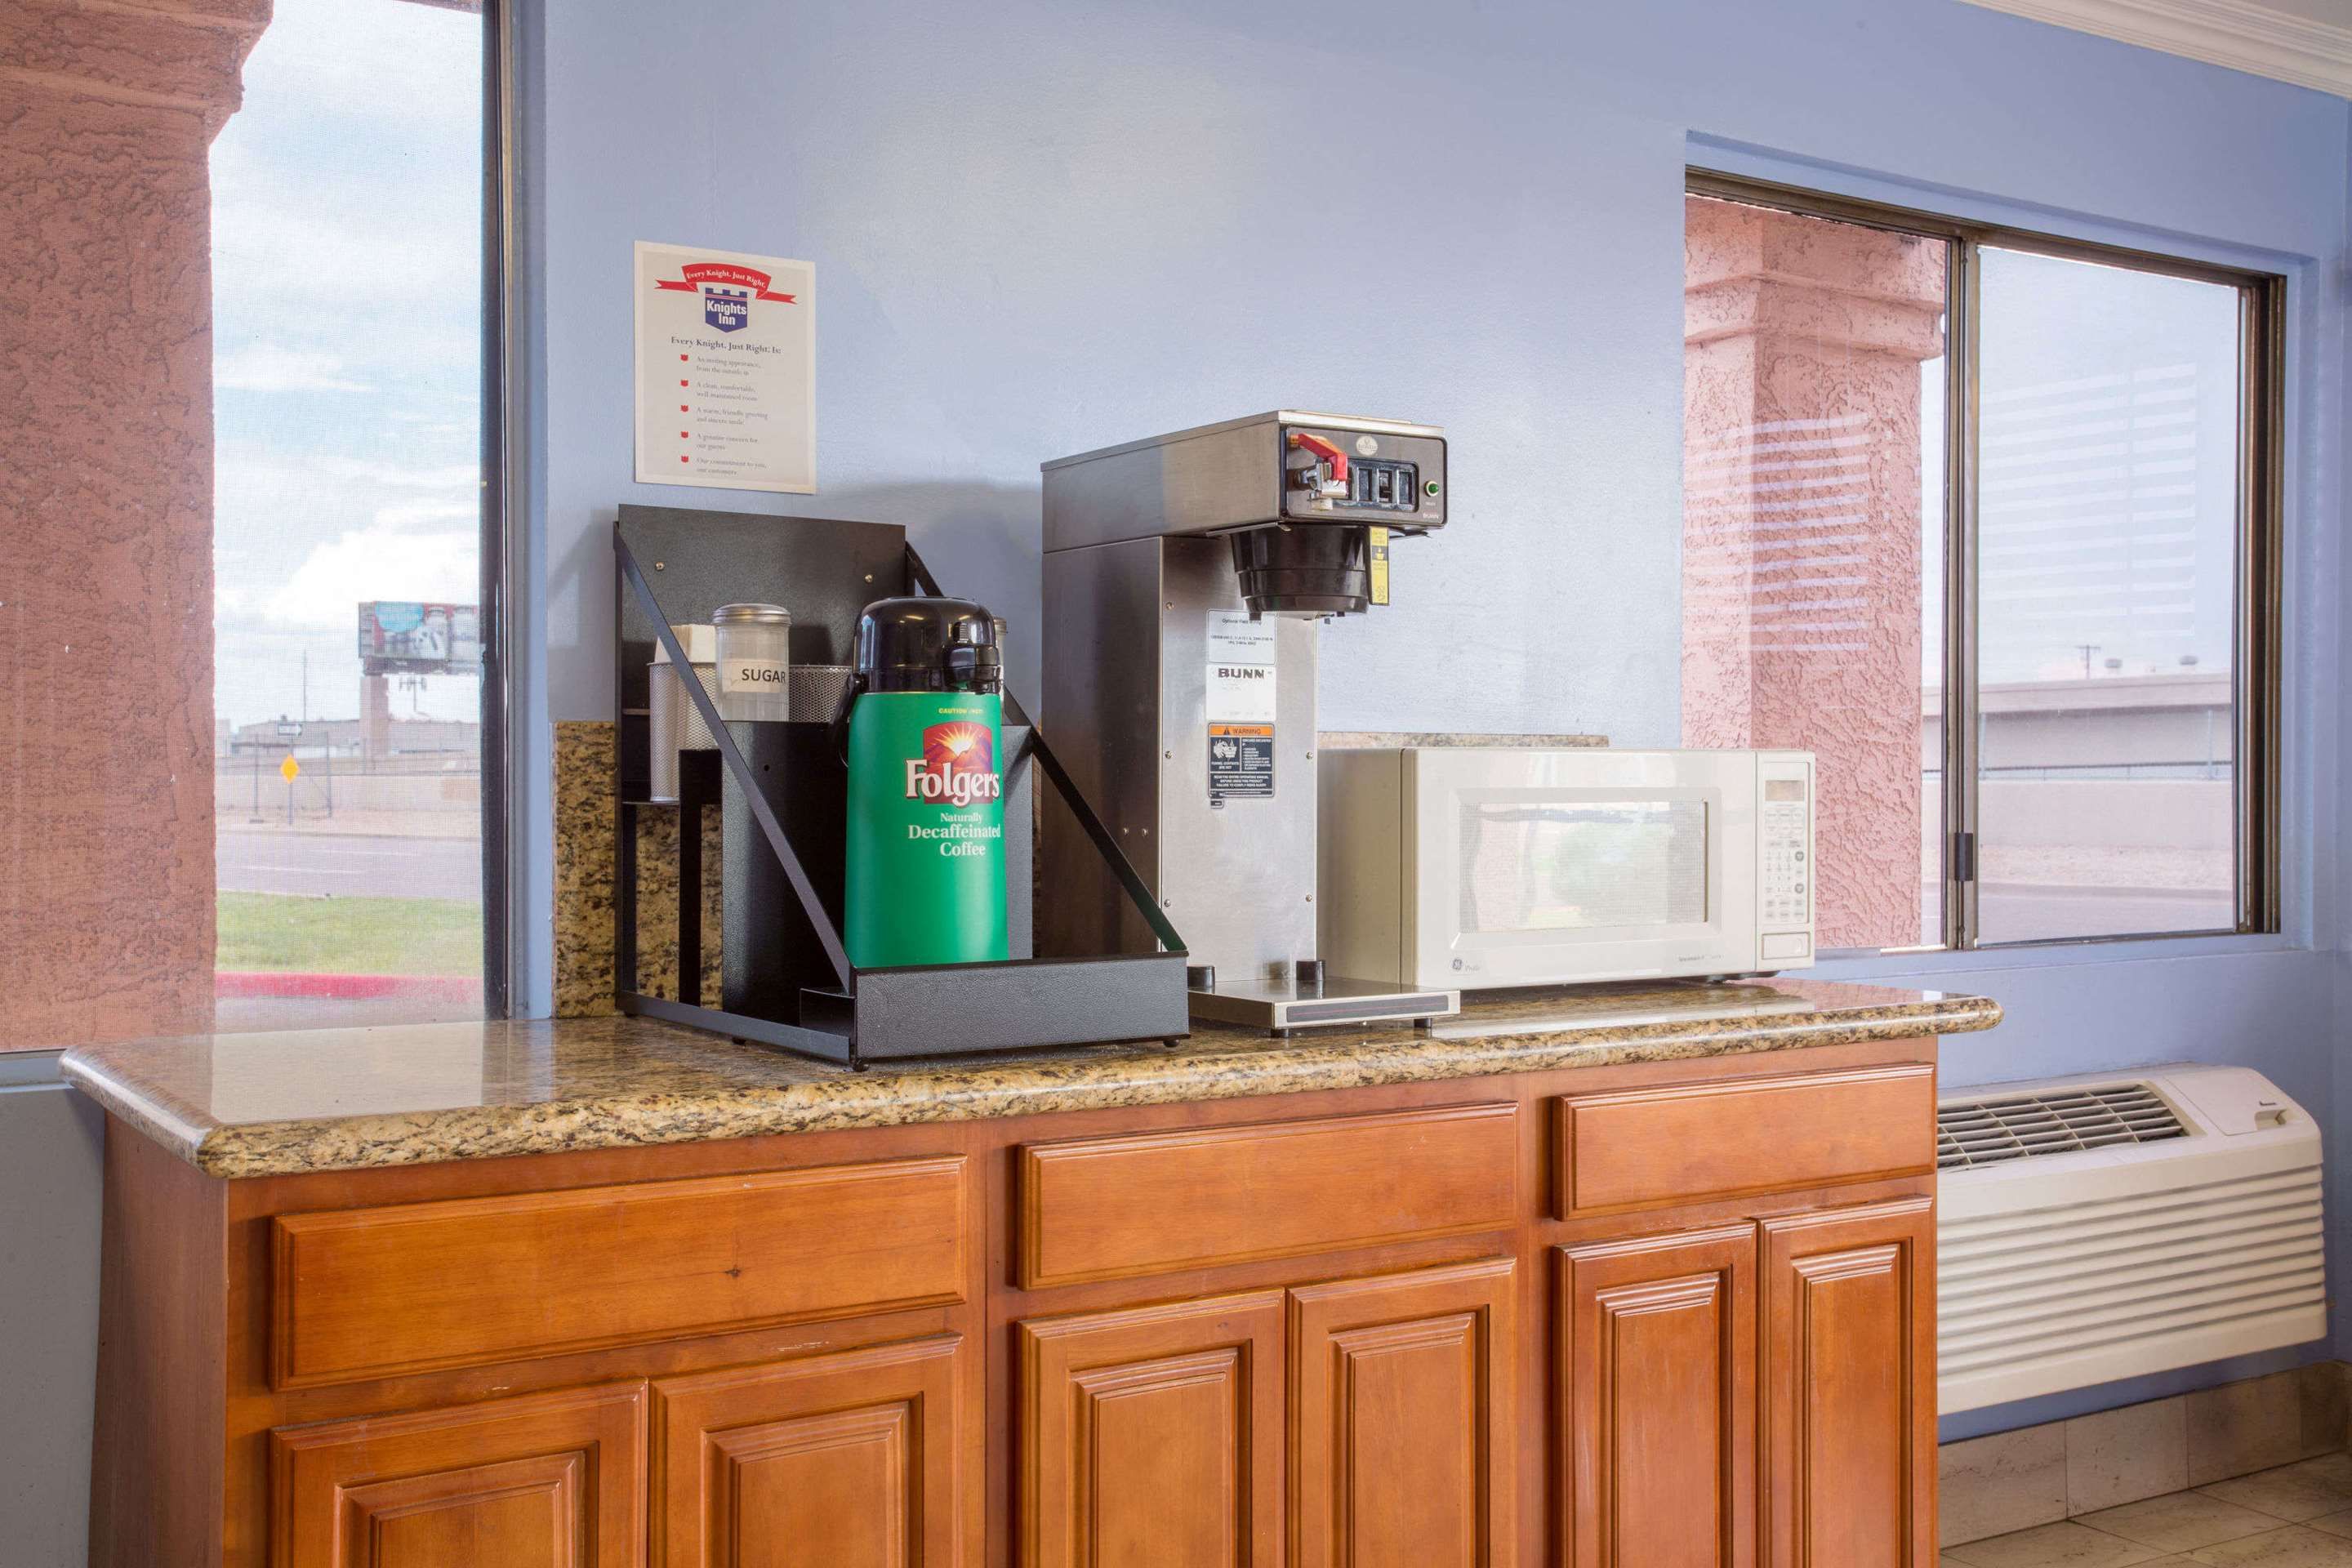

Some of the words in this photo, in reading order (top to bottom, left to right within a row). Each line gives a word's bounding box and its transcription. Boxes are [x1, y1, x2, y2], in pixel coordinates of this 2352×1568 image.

[687, 271, 705, 279] Every
[706, 269, 731, 278] Knight.
[733, 271, 746, 281] Just
[746, 275, 766, 288] Right.
[706, 299, 747, 315] Knights
[718, 313, 736, 325] Inn
[671, 336, 694, 348] Every
[696, 338, 727, 351] Knight.
[728, 341, 743, 351] Just
[742, 668, 786, 684] SUGAR
[1218, 667, 1265, 679] BUNN
[905, 759, 1000, 808] Folgers
[940, 812, 982, 823] Naturally
[907, 822, 1001, 840] Decaffeinated
[940, 841, 987, 857] Coffee
